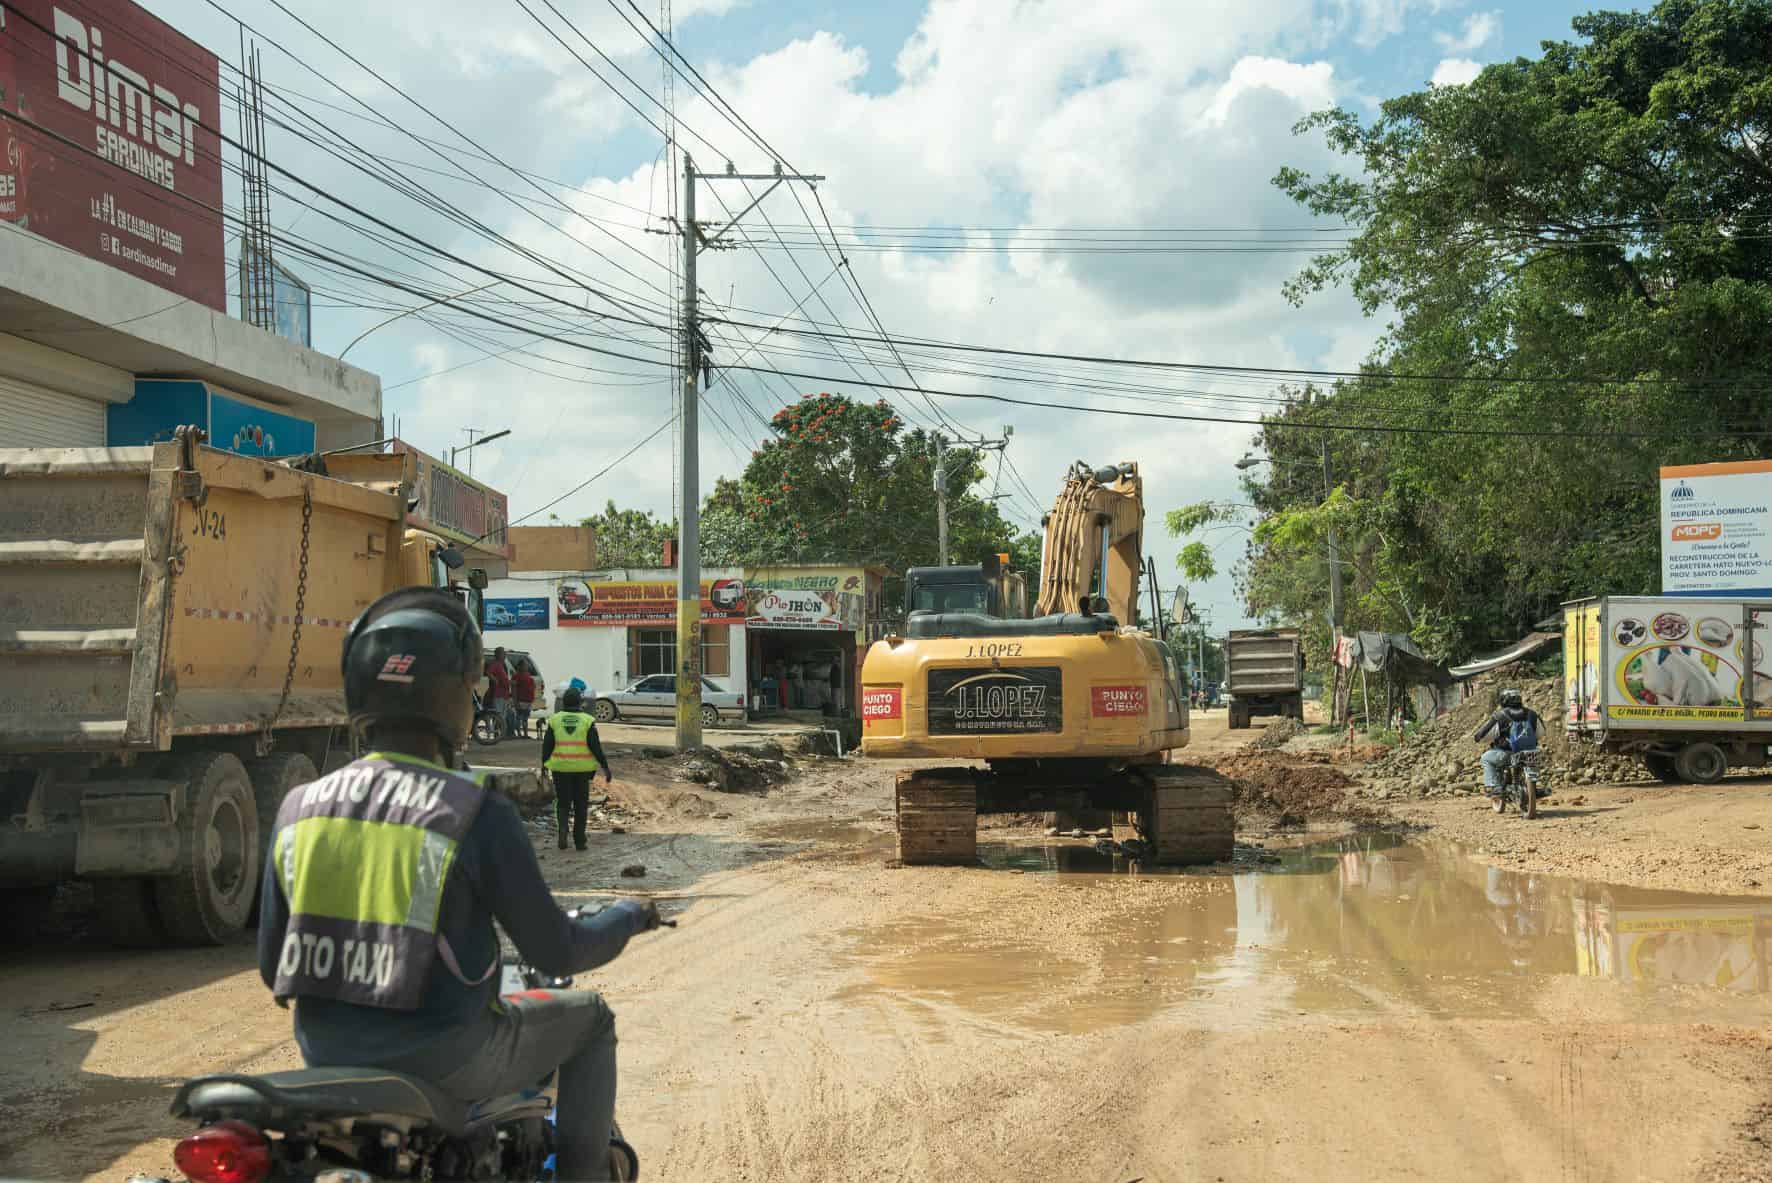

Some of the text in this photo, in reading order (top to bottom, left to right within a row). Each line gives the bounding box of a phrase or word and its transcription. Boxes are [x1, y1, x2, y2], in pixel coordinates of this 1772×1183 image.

[53, 6, 201, 166] Dimar
[96, 124, 175, 191] SARDINAS
[1716, 506, 1768, 516] DOMINICANA
[1676, 526, 1716, 537] MOPC
[1103, 689, 1144, 701] PUNTO
[864, 704, 891, 716] CIEGO
[1105, 701, 1144, 712] CIEGO
[377, 768, 446, 811] TAXI
[279, 931, 395, 987] OTO TAXI
